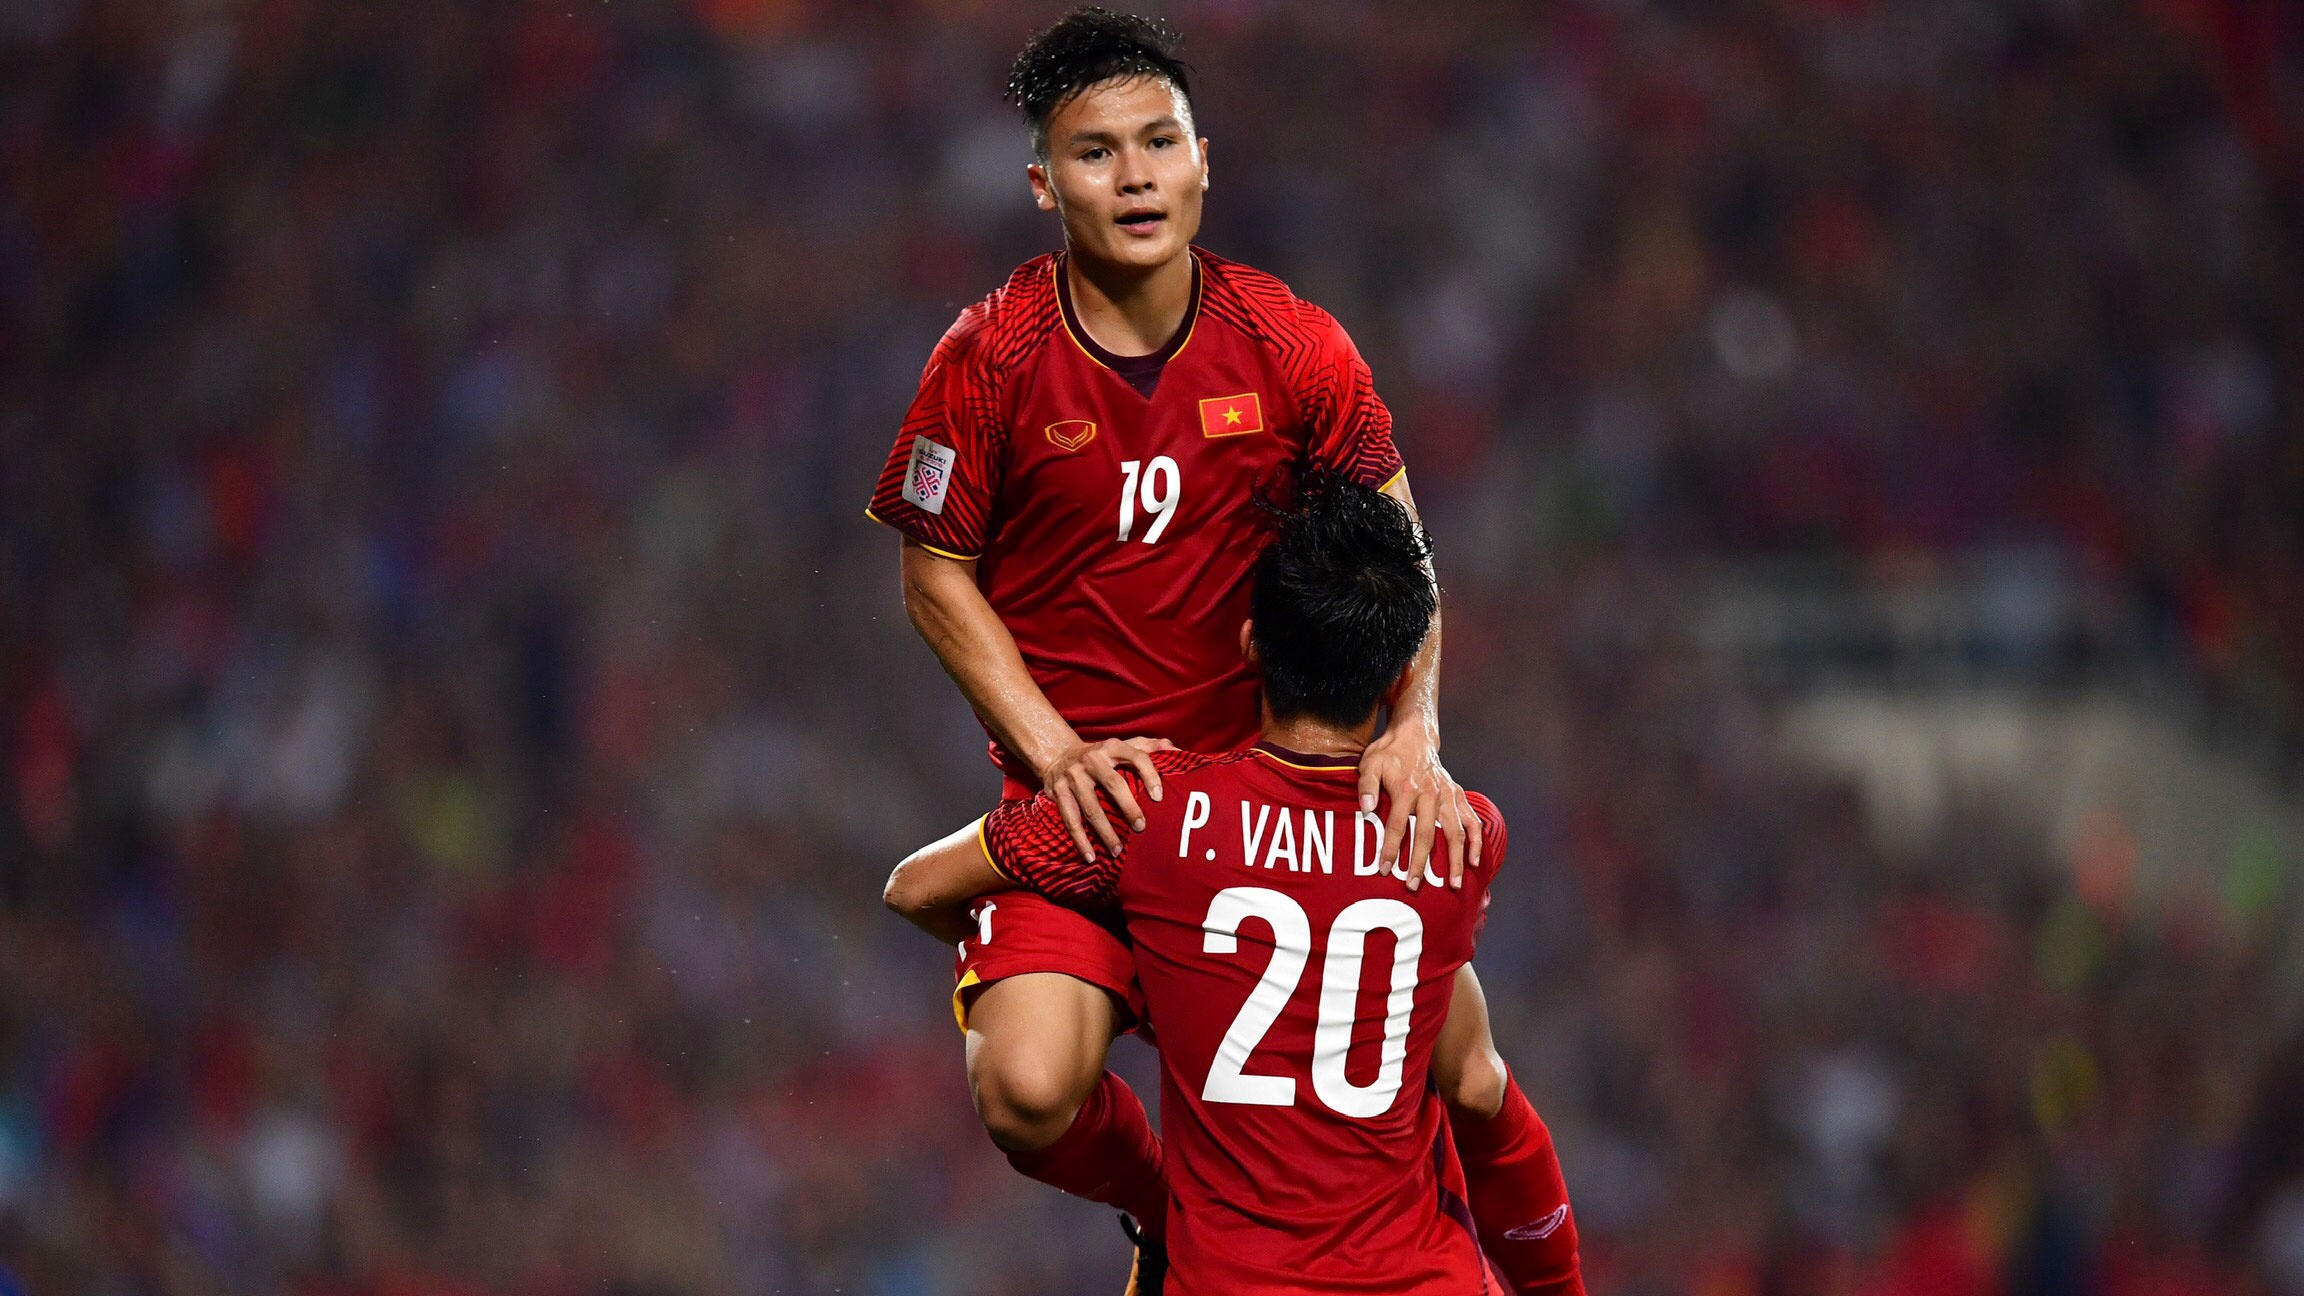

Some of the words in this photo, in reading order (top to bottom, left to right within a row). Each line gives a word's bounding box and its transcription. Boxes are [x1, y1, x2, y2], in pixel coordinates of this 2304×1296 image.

[1116, 455, 1181, 544] 19
[1178, 791, 1216, 861] P.
[1240, 800, 1334, 875] VAN
[1202, 886, 1424, 1118] 20
